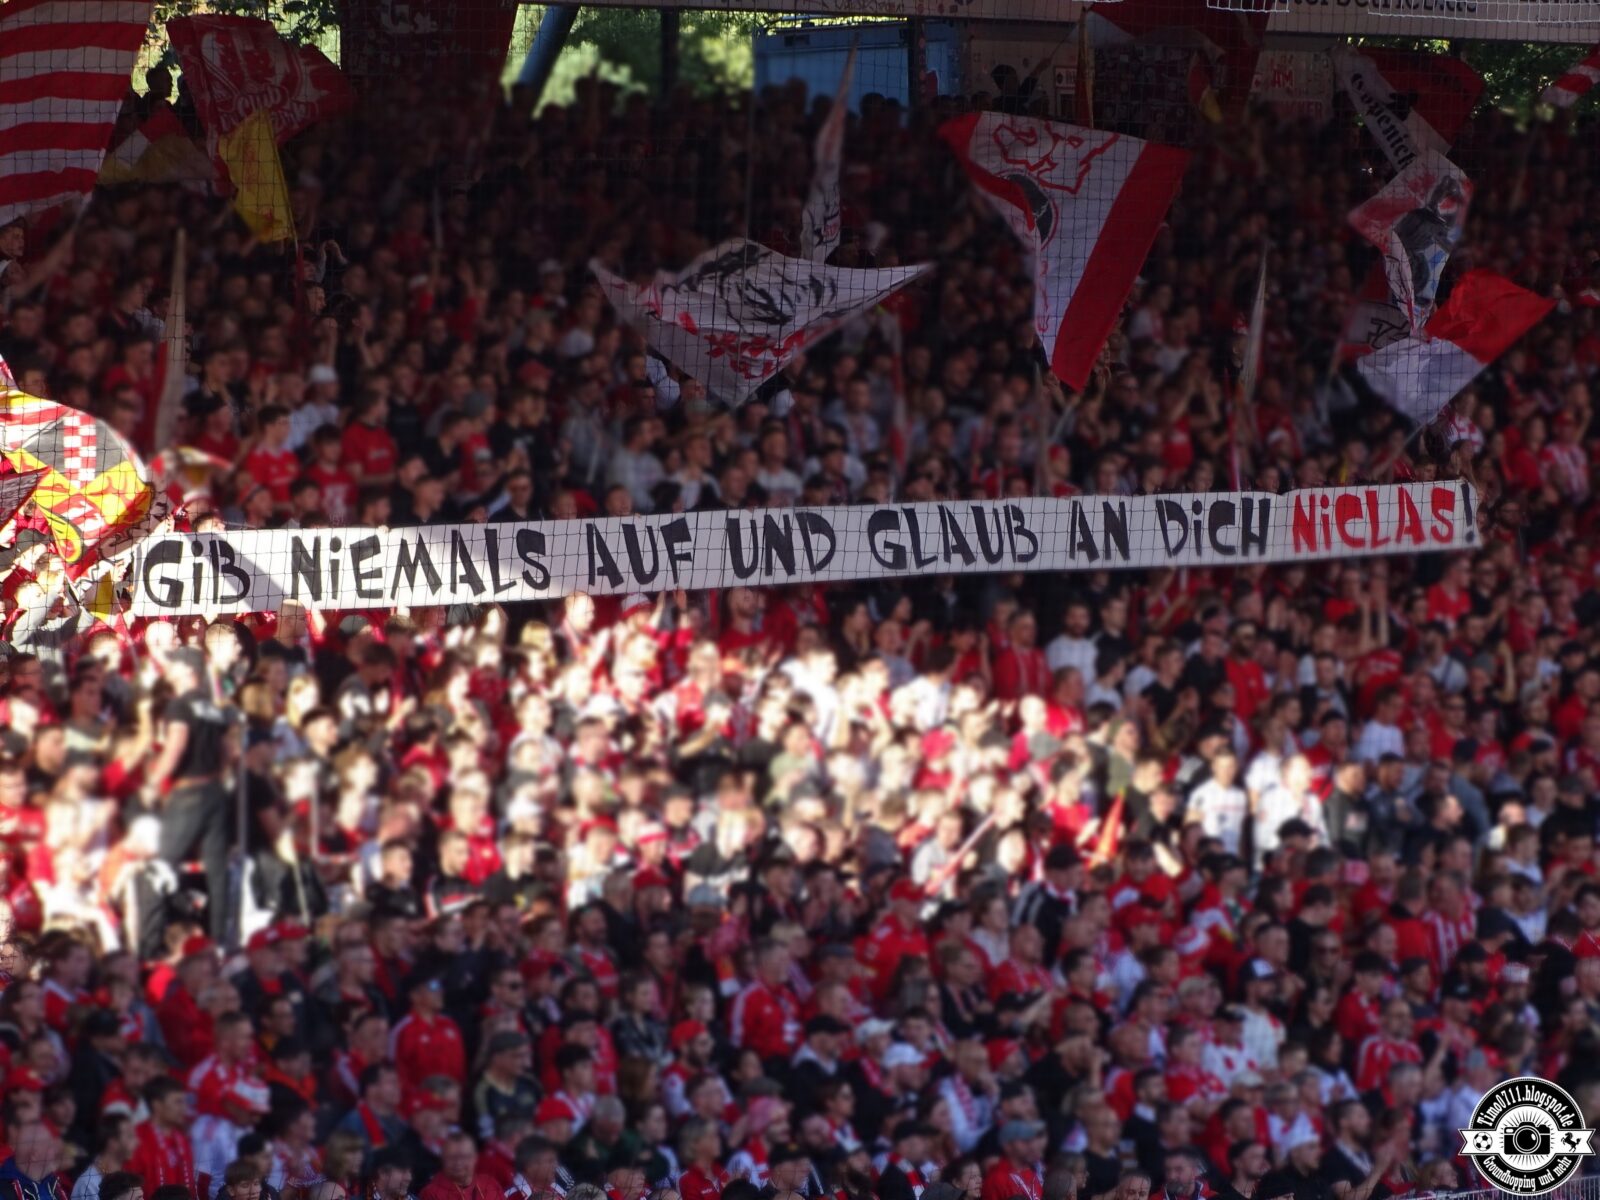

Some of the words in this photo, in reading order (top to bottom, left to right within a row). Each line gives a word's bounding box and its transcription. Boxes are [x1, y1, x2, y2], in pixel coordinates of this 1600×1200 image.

[586, 517, 693, 588] AUF
[726, 511, 836, 579] UND
[868, 503, 1039, 570] GLAUB
[1068, 499, 1131, 563] AN
